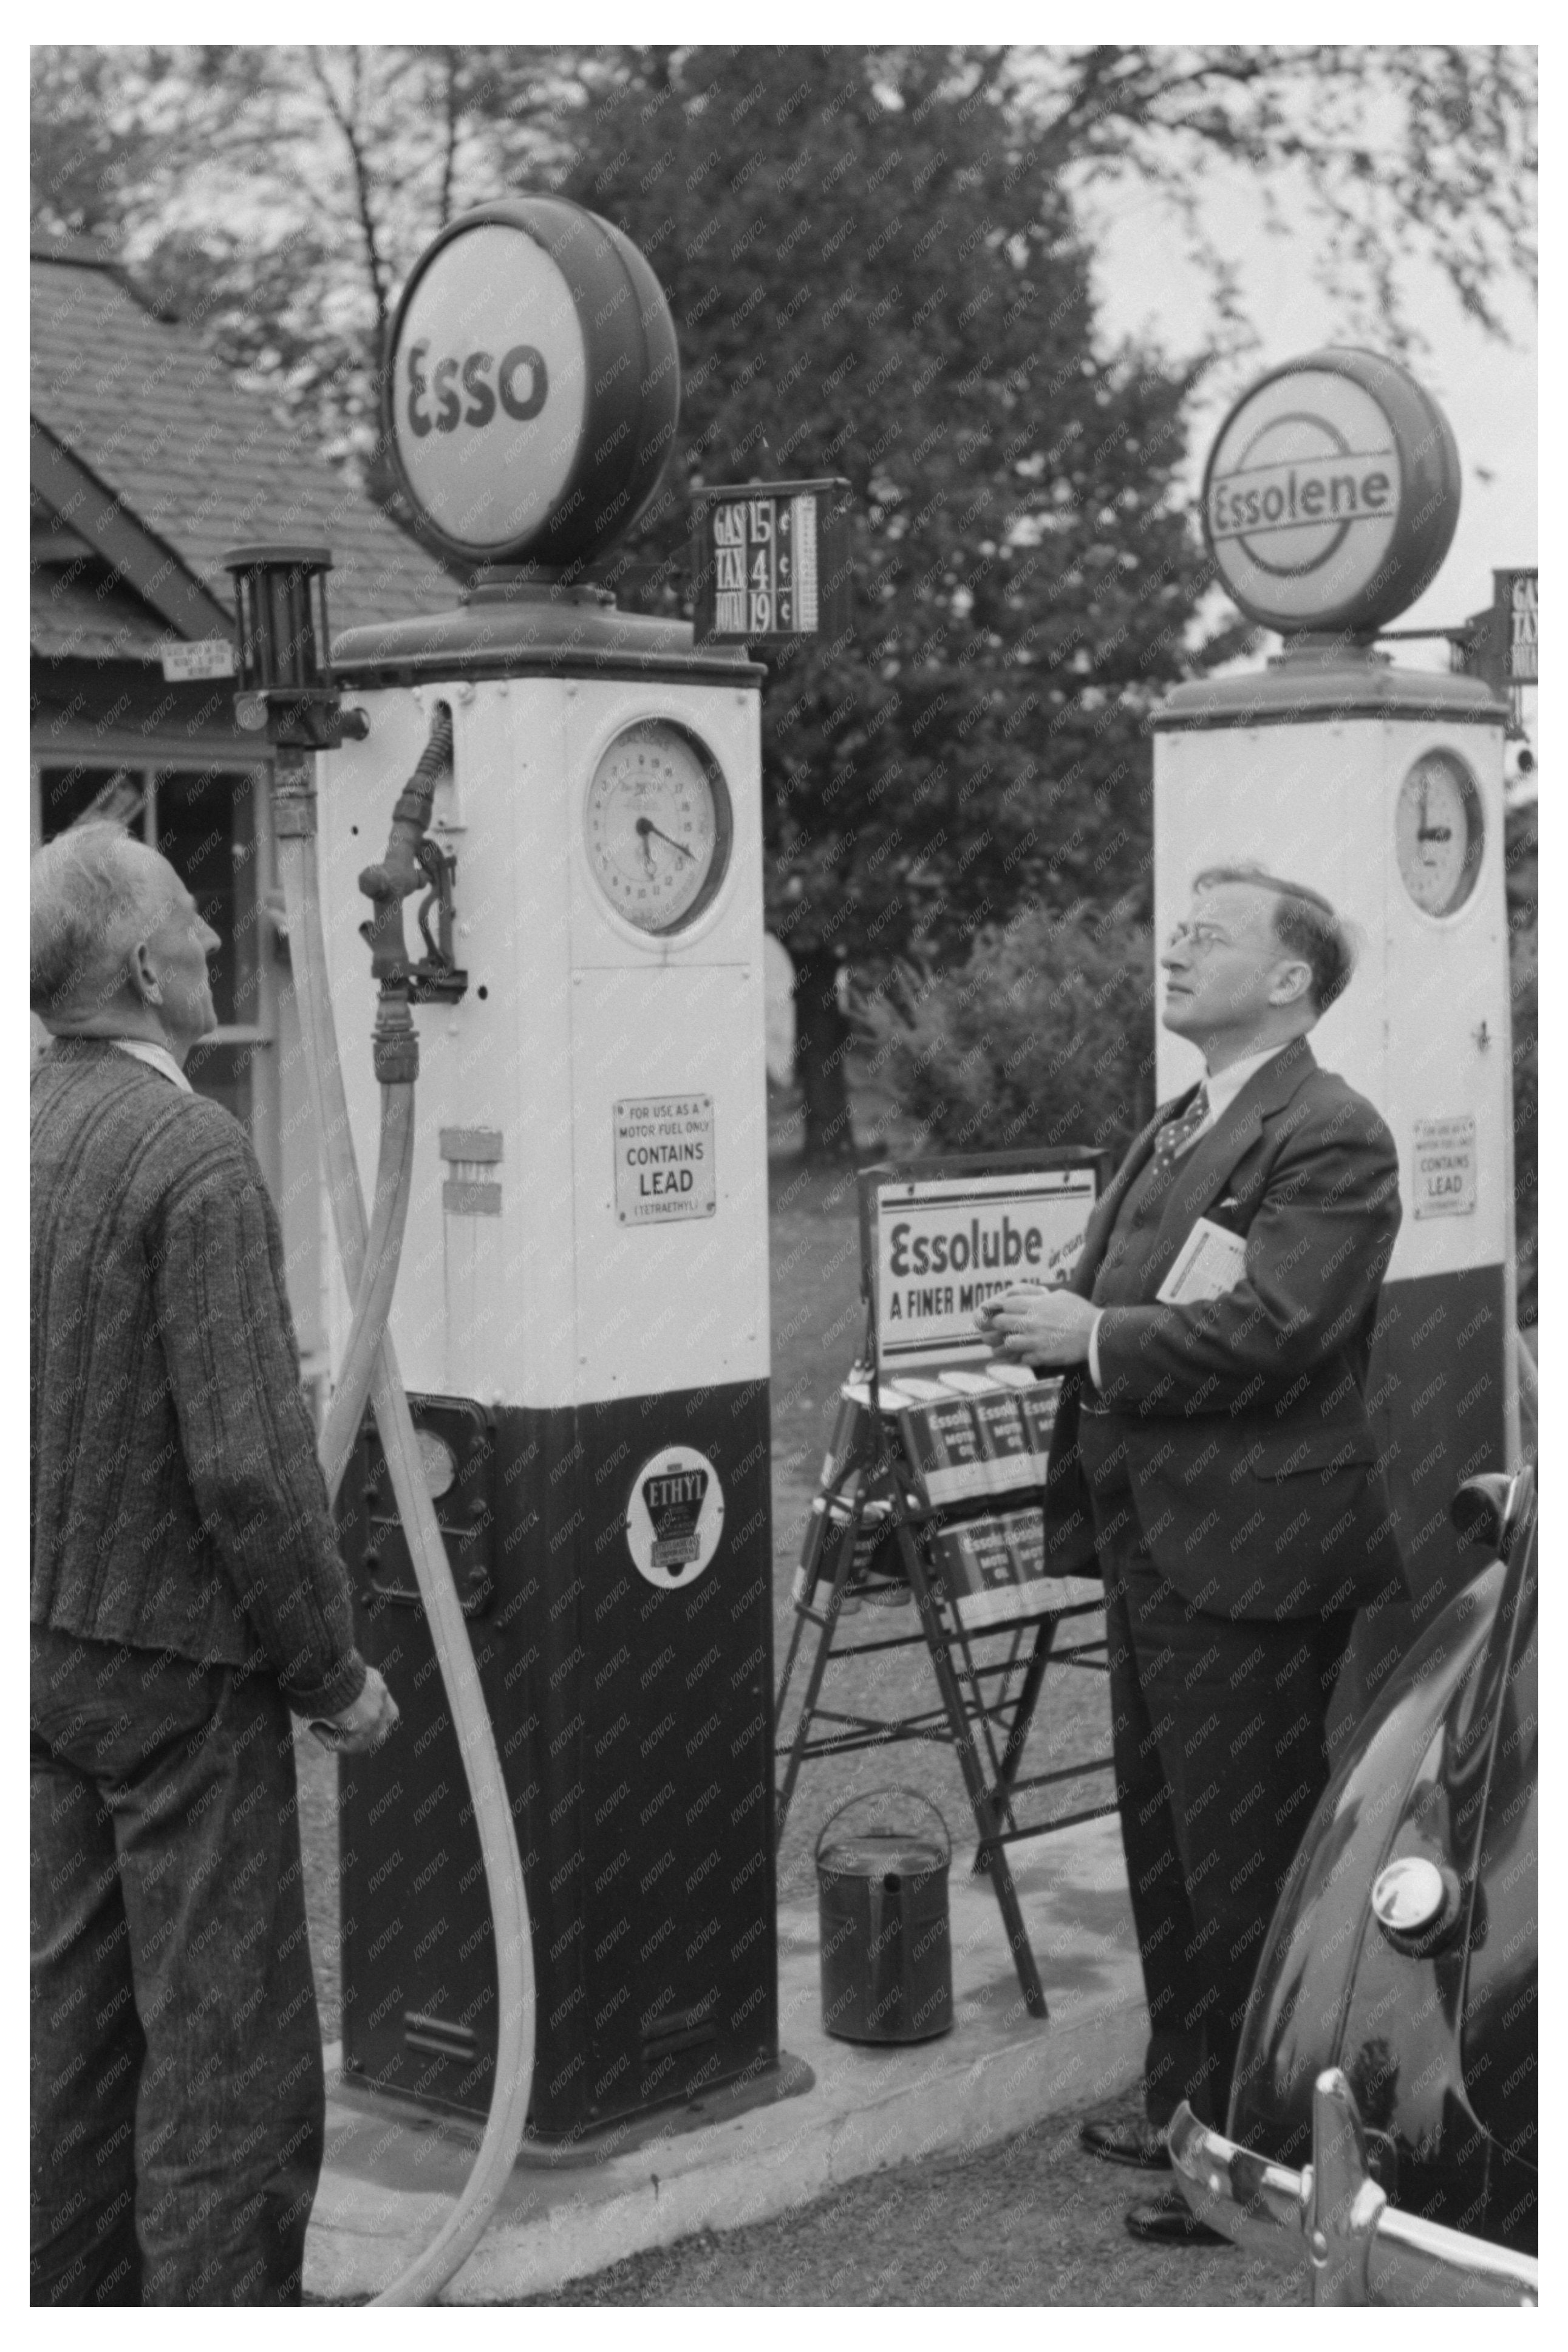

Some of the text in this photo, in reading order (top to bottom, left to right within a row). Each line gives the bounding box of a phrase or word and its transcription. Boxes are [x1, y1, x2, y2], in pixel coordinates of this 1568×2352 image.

[1213, 470, 1391, 530] Essolene
[714, 503, 746, 545] GAS
[749, 500, 771, 543] 15
[752, 550, 769, 590] 4
[750, 593, 770, 632] 19
[630, 1107, 650, 1120] FOR
[676, 1103, 689, 1116] AS
[692, 1103, 700, 1114] A
[619, 1120, 709, 1138] MOTOR FUEL ONLY
[627, 1142, 704, 1167] CONTAINS
[640, 1169, 694, 1196] LEAD
[1428, 1175, 1462, 1196] LEAD
[890, 1216, 1043, 1277] Essolube
[890, 1292, 902, 1320] A
[907, 1287, 954, 1318] FINER
[649, 1474, 705, 1507] ETHYL
